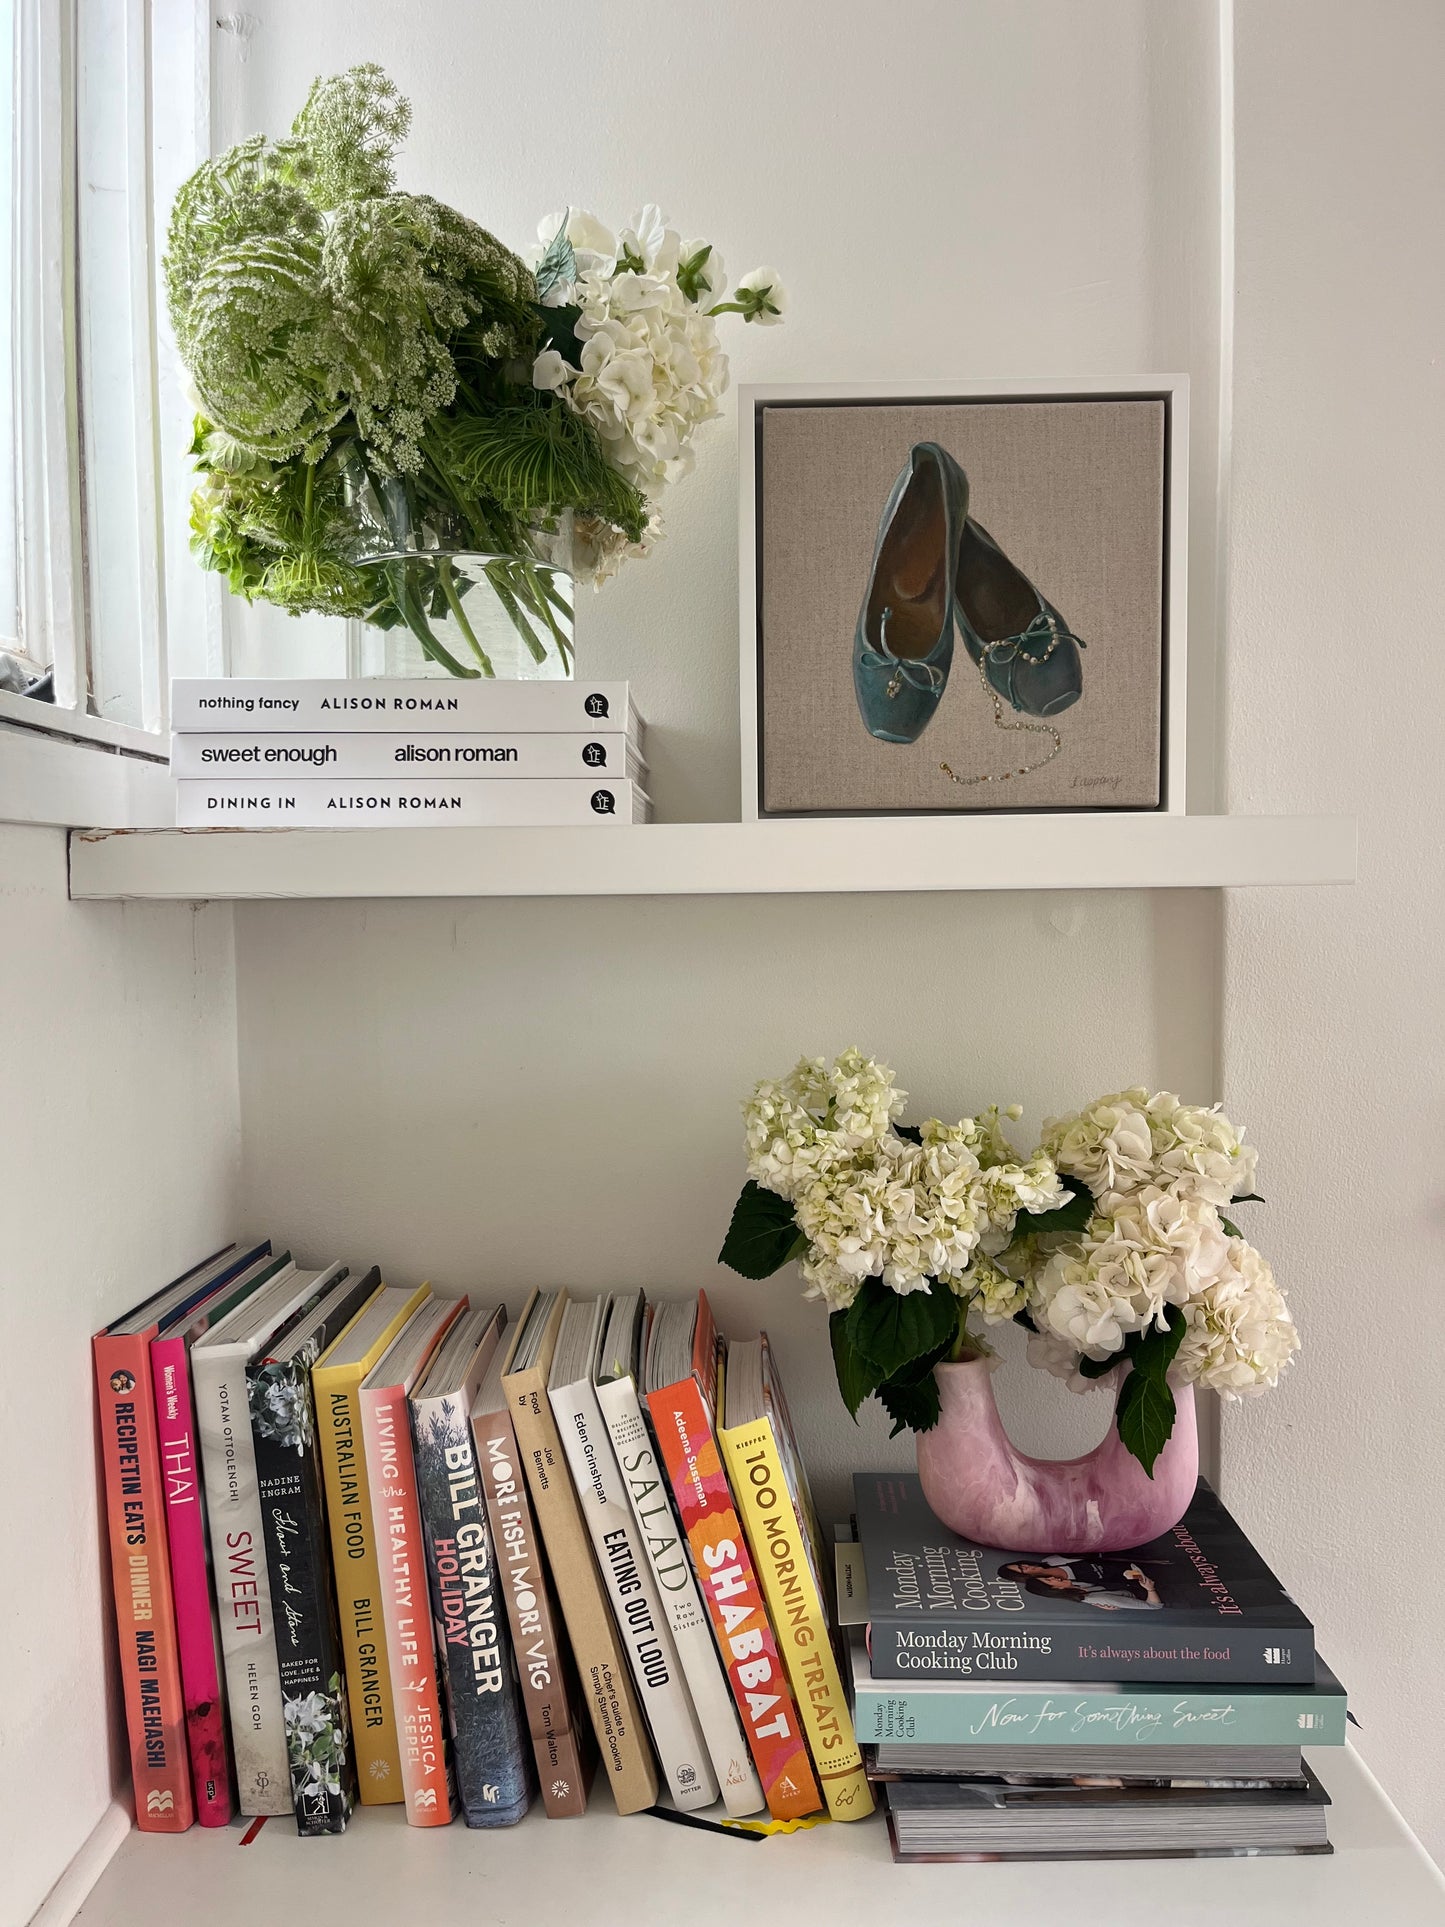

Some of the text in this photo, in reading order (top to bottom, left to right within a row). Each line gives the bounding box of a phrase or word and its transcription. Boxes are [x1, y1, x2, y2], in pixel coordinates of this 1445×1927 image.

[199, 696, 300, 711] nothing fancy
[321, 698, 459, 710] ALISON ROMAN
[201, 744, 338, 765] sweet enough
[394, 744, 518, 762] alison roman
[207, 797, 296, 809] DINING IN
[327, 797, 462, 809] ALISON ROMAN
[163, 1365, 179, 1419] Women's Weekly
[518, 1396, 527, 1407] by
[530, 1391, 542, 1415] Food
[218, 1384, 240, 1502] YOTAM OTTOLENGHI
[543, 1447, 555, 1466] Joel
[573, 1412, 607, 1504] Eden Grinshpan
[673, 1411, 708, 1508] Adeena Sussman
[736, 1435, 767, 1450] KIEFFER
[114, 1402, 146, 1546] RECIPETIN EATS
[164, 1432, 194, 1505] THAI
[260, 1475, 300, 1487] NADINE
[330, 1393, 365, 1560] AUSTRALIAN FOOD
[487, 1436, 519, 1506] MORE
[533, 1450, 549, 1490] Bennetts
[261, 1486, 301, 1498] INGRAM
[375, 1404, 418, 1666] LIVING the HEALTHY LIFE
[623, 1450, 689, 1592] SALAD
[128, 1555, 154, 1622] DINNER
[226, 1531, 262, 1634] SWEET
[279, 1563, 302, 1594] and
[444, 1443, 503, 1696] BILL GRANGER
[885, 1550, 923, 1610] Monday
[922, 1546, 957, 1610] Morning
[951, 1549, 991, 1611] Cooking
[1189, 1555, 1229, 1594] always
[434, 1538, 470, 1647] HOLIDAY
[510, 1565, 542, 1636] MORE
[603, 1528, 670, 1689] EATING OUT LOUD
[674, 1602, 691, 1611] Two
[745, 1450, 843, 1750] 100 MORNING TREATS
[987, 1576, 1026, 1611] Club
[1210, 1596, 1243, 1615] It's
[673, 1618, 704, 1631] Sisters
[702, 1538, 791, 1741] SHABBAT
[896, 1631, 1052, 1654] Monday Morning
[281, 1660, 304, 1669] BAKED
[353, 1598, 383, 1728] BILL GRANGER
[525, 1640, 551, 1690] VEG
[896, 1652, 1018, 1674] Cooking Club
[1079, 1645, 1231, 1662] It's always about the food
[136, 1630, 167, 1769] NAGI MAEHASHI
[247, 1663, 262, 1731] HELEN GOH
[284, 1675, 320, 1686] HAPPINESS
[600, 1663, 625, 1737] A Chef's Guide to
[418, 1704, 437, 1775] JESSICA
[541, 1703, 559, 1767] Tom Walton
[590, 1666, 623, 1772] Simply Stunning Cooking
[874, 1703, 884, 1738] Monday
[884, 1699, 897, 1738] Morning
[896, 1700, 908, 1738] Cooking
[907, 1716, 915, 1738] Club
[970, 1698, 1236, 1741] Now for Something Sweet
[404, 1714, 420, 1767] SEPEL
[680, 1785, 702, 1796] POTTER
[726, 1773, 747, 1787] A&U
